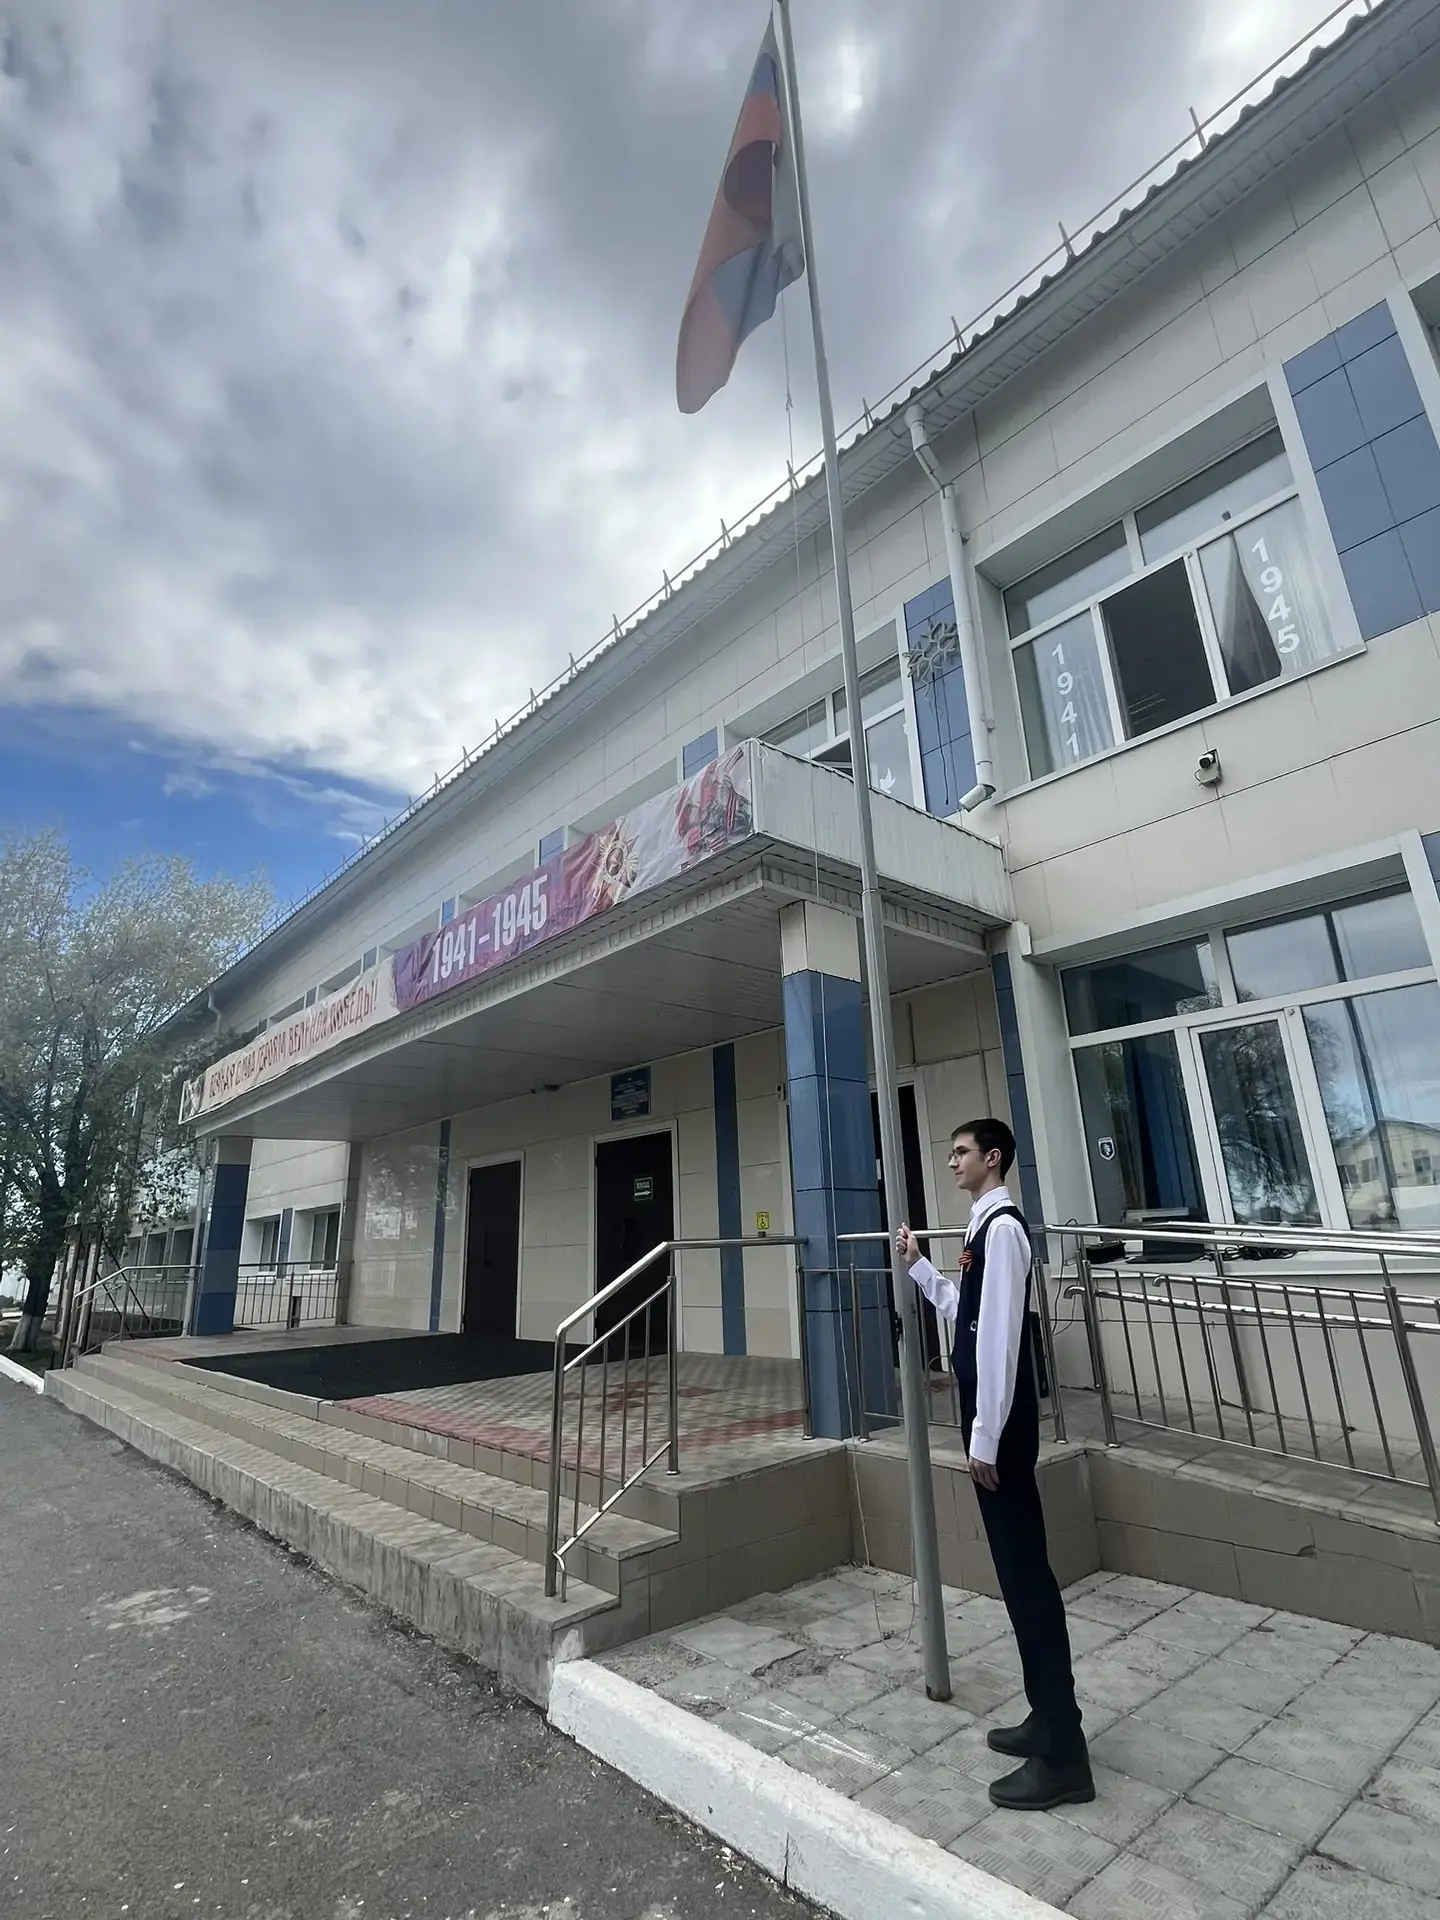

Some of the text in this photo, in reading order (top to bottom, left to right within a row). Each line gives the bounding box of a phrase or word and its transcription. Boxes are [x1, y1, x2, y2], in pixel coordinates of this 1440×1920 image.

[1251, 537, 1300, 653] 1945
[1052, 643, 1081, 756] 1941
[257, 1032, 286, 1071] ГЕРОЯМ
[330, 978, 378, 1033] ПОБЕДЫ!
